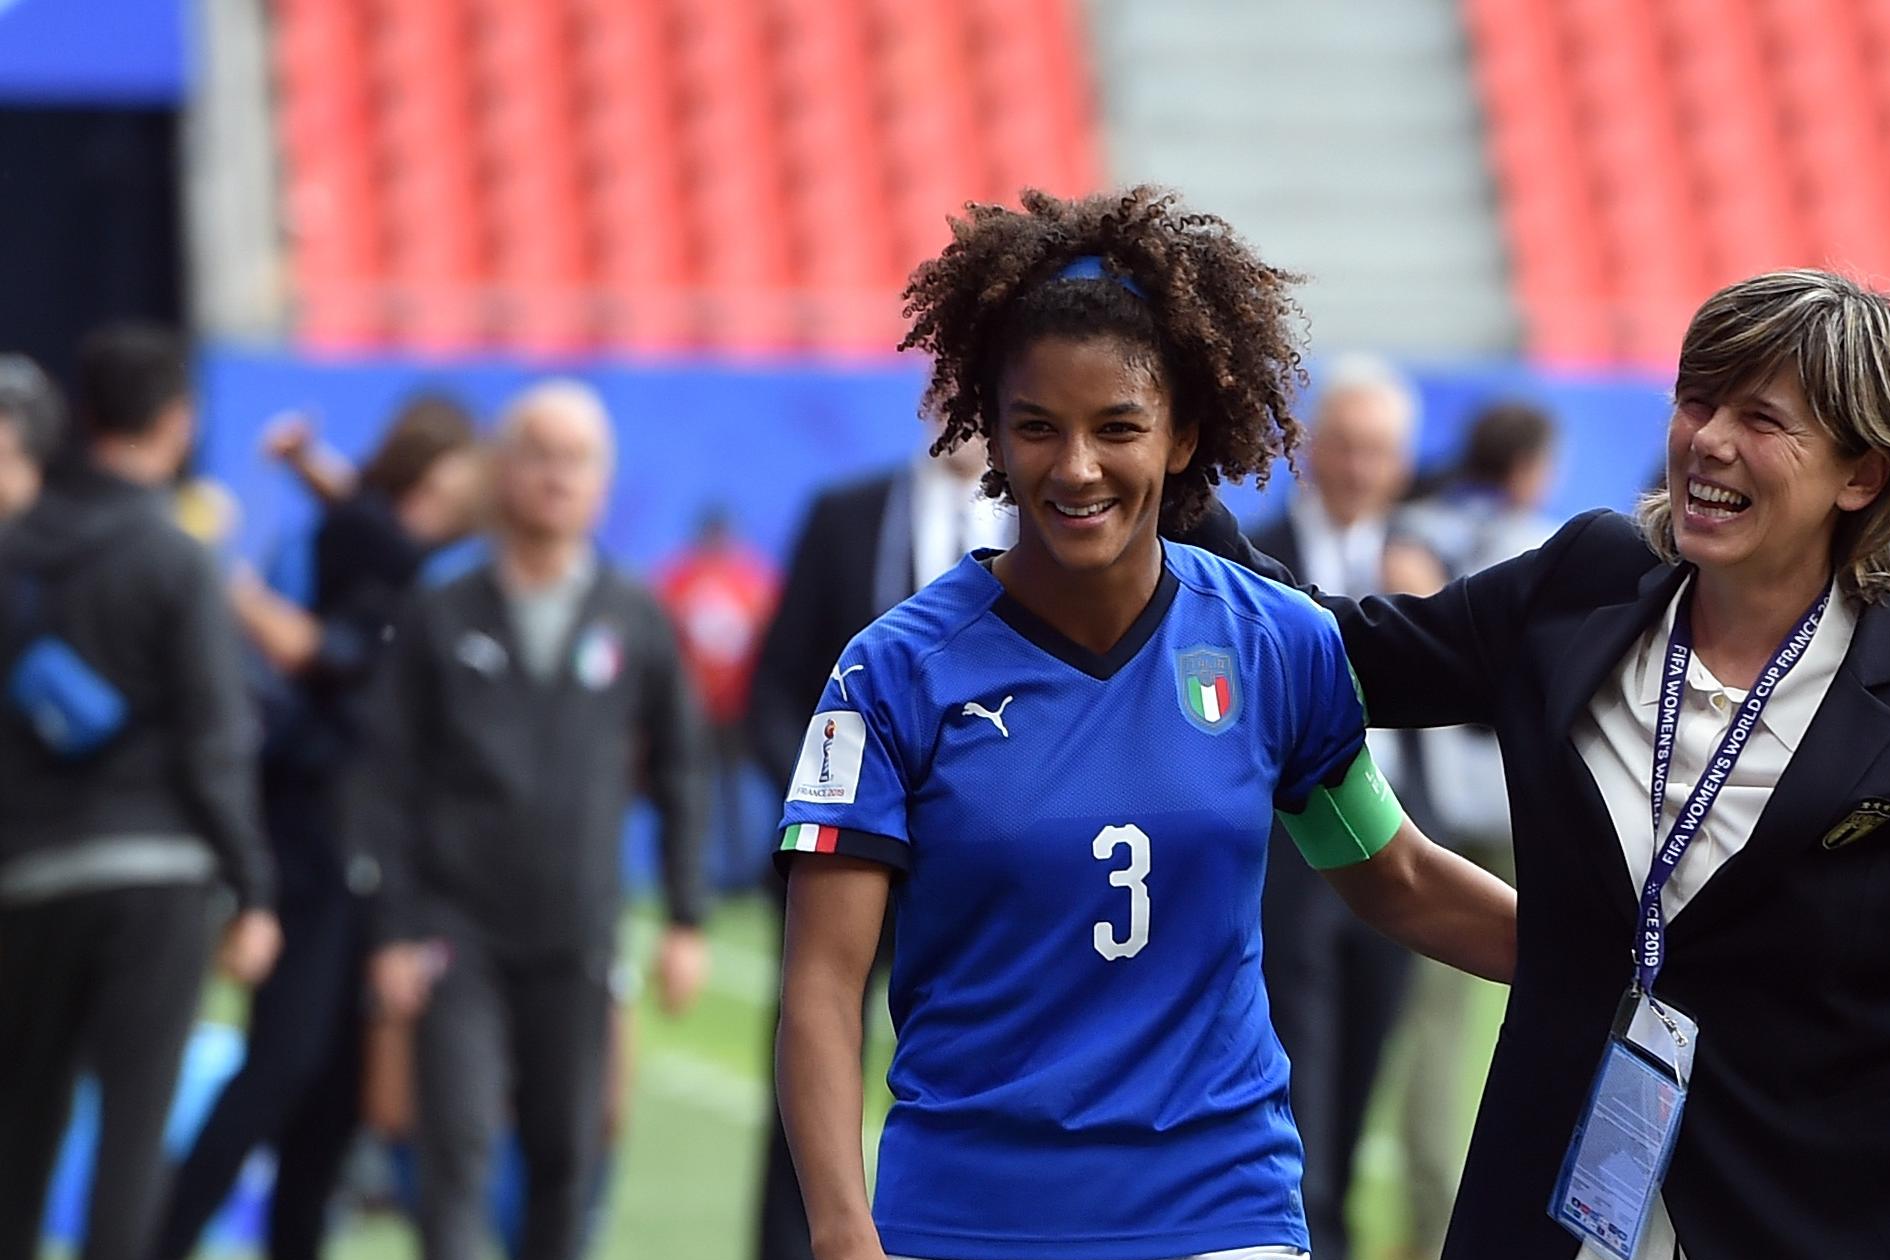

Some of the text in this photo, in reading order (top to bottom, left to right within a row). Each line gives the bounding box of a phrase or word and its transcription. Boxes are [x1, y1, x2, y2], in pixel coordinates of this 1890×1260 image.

[1668, 644, 1688, 677] FIFA
[1657, 680, 1681, 760] WOMEN'S
[1661, 834, 1690, 866] FIFA
[1681, 757, 1731, 831] WOMEN'S
[1722, 698, 1762, 756] WORLD
[1755, 666, 1780, 697] CUP
[1775, 613, 1820, 668] FRANCE
[796, 786, 845, 798] FRANCE 2019
[1093, 823, 1151, 961] 3
[1644, 931, 1661, 968] 2019
